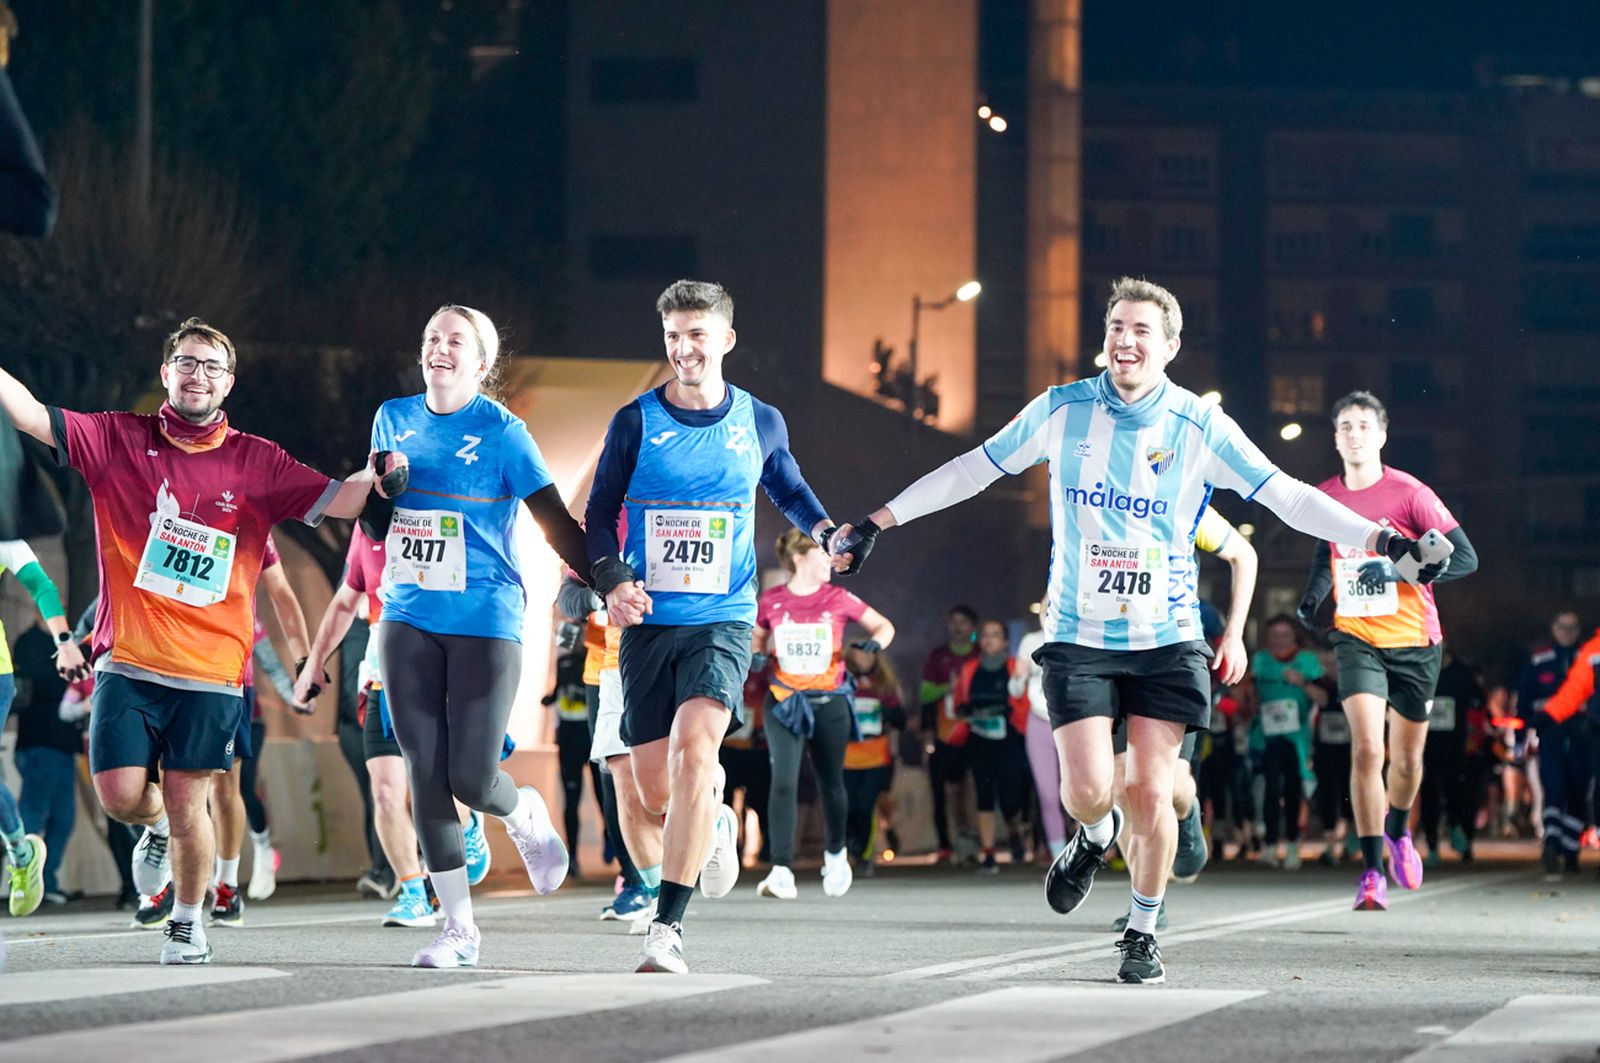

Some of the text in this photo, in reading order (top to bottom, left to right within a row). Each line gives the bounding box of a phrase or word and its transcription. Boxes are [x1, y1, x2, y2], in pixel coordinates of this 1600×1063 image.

[399, 517, 420, 527] NOCHE
[422, 519, 432, 527] DE
[664, 519, 690, 527] NOCHE
[691, 520, 702, 528] DE
[172, 526, 197, 540] NOCHE
[198, 533, 209, 543] DE
[392, 525, 406, 534] SAN
[655, 528, 672, 538] SAN
[160, 531, 177, 545] SAN
[401, 536, 446, 562] 2477
[663, 539, 714, 564] 2479
[1101, 549, 1127, 559] NOCHE
[1129, 550, 1139, 559] DE
[163, 544, 214, 581] 7812
[1090, 558, 1108, 568] SAN
[1097, 569, 1151, 595] 2478
[787, 642, 821, 656] 6832
